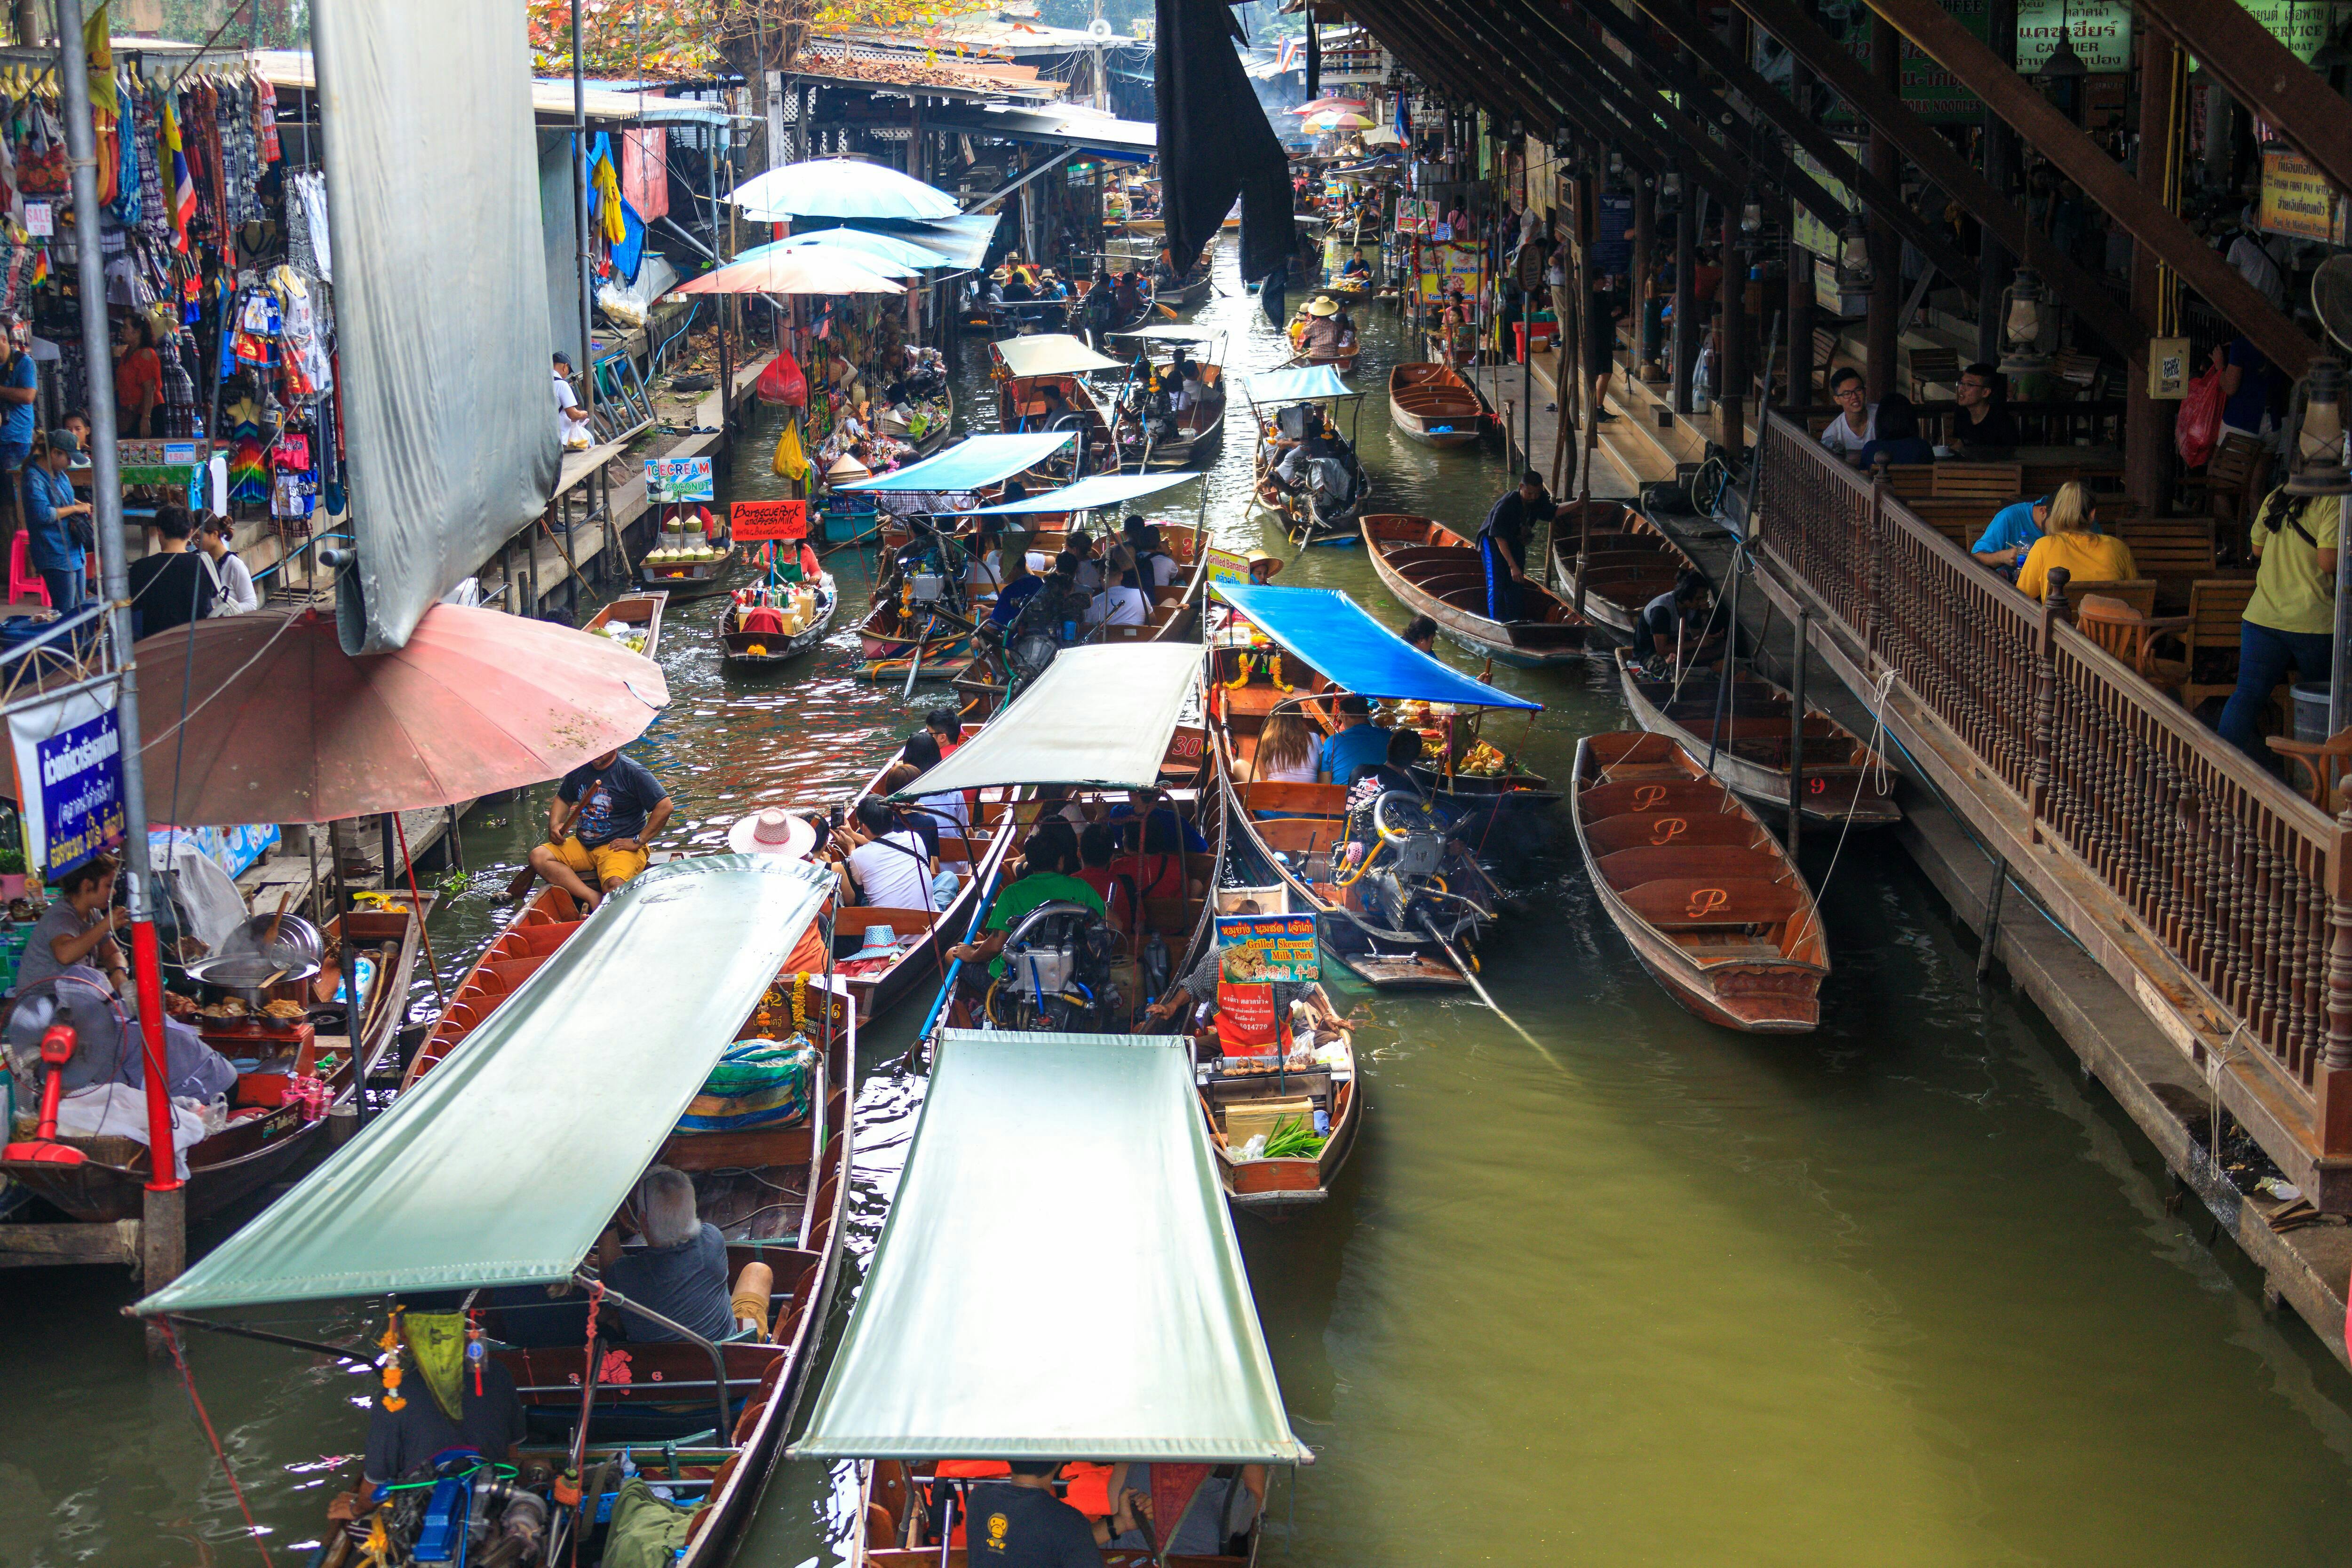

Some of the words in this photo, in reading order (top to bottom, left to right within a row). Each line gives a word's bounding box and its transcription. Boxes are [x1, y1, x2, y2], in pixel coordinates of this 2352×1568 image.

[2035, 42, 2099, 53] CAIER
[1932, 99, 1982, 113] NOODLES
[2274, 179, 2288, 190] FINISH
[2289, 181, 2302, 192] FIRST
[2304, 182, 2313, 194] PAY
[27, 208, 50, 223] SALE
[646, 461, 710, 477] ICECREAM
[664, 481, 710, 493] COCONUT
[1208, 554, 1226, 568] Grilled
[1226, 559, 1248, 574] Bananas
[1172, 736, 1203, 757] 30
[1810, 777, 1825, 794] 9
[1687, 888, 1727, 918] P
[1221, 922, 1251, 938] หมูย่าง
[1255, 922, 1284, 935] นมสด
[1287, 919, 1314, 934] เจ้าเก่า
[1247, 938, 1275, 949] Grilled
[1278, 938, 1314, 949] Skewered
[1271, 950, 1292, 960] Milk
[1295, 950, 1313, 960] Pork
[1255, 965, 1290, 980] 烤猪肉
[1295, 964, 1319, 980] 牛奶
